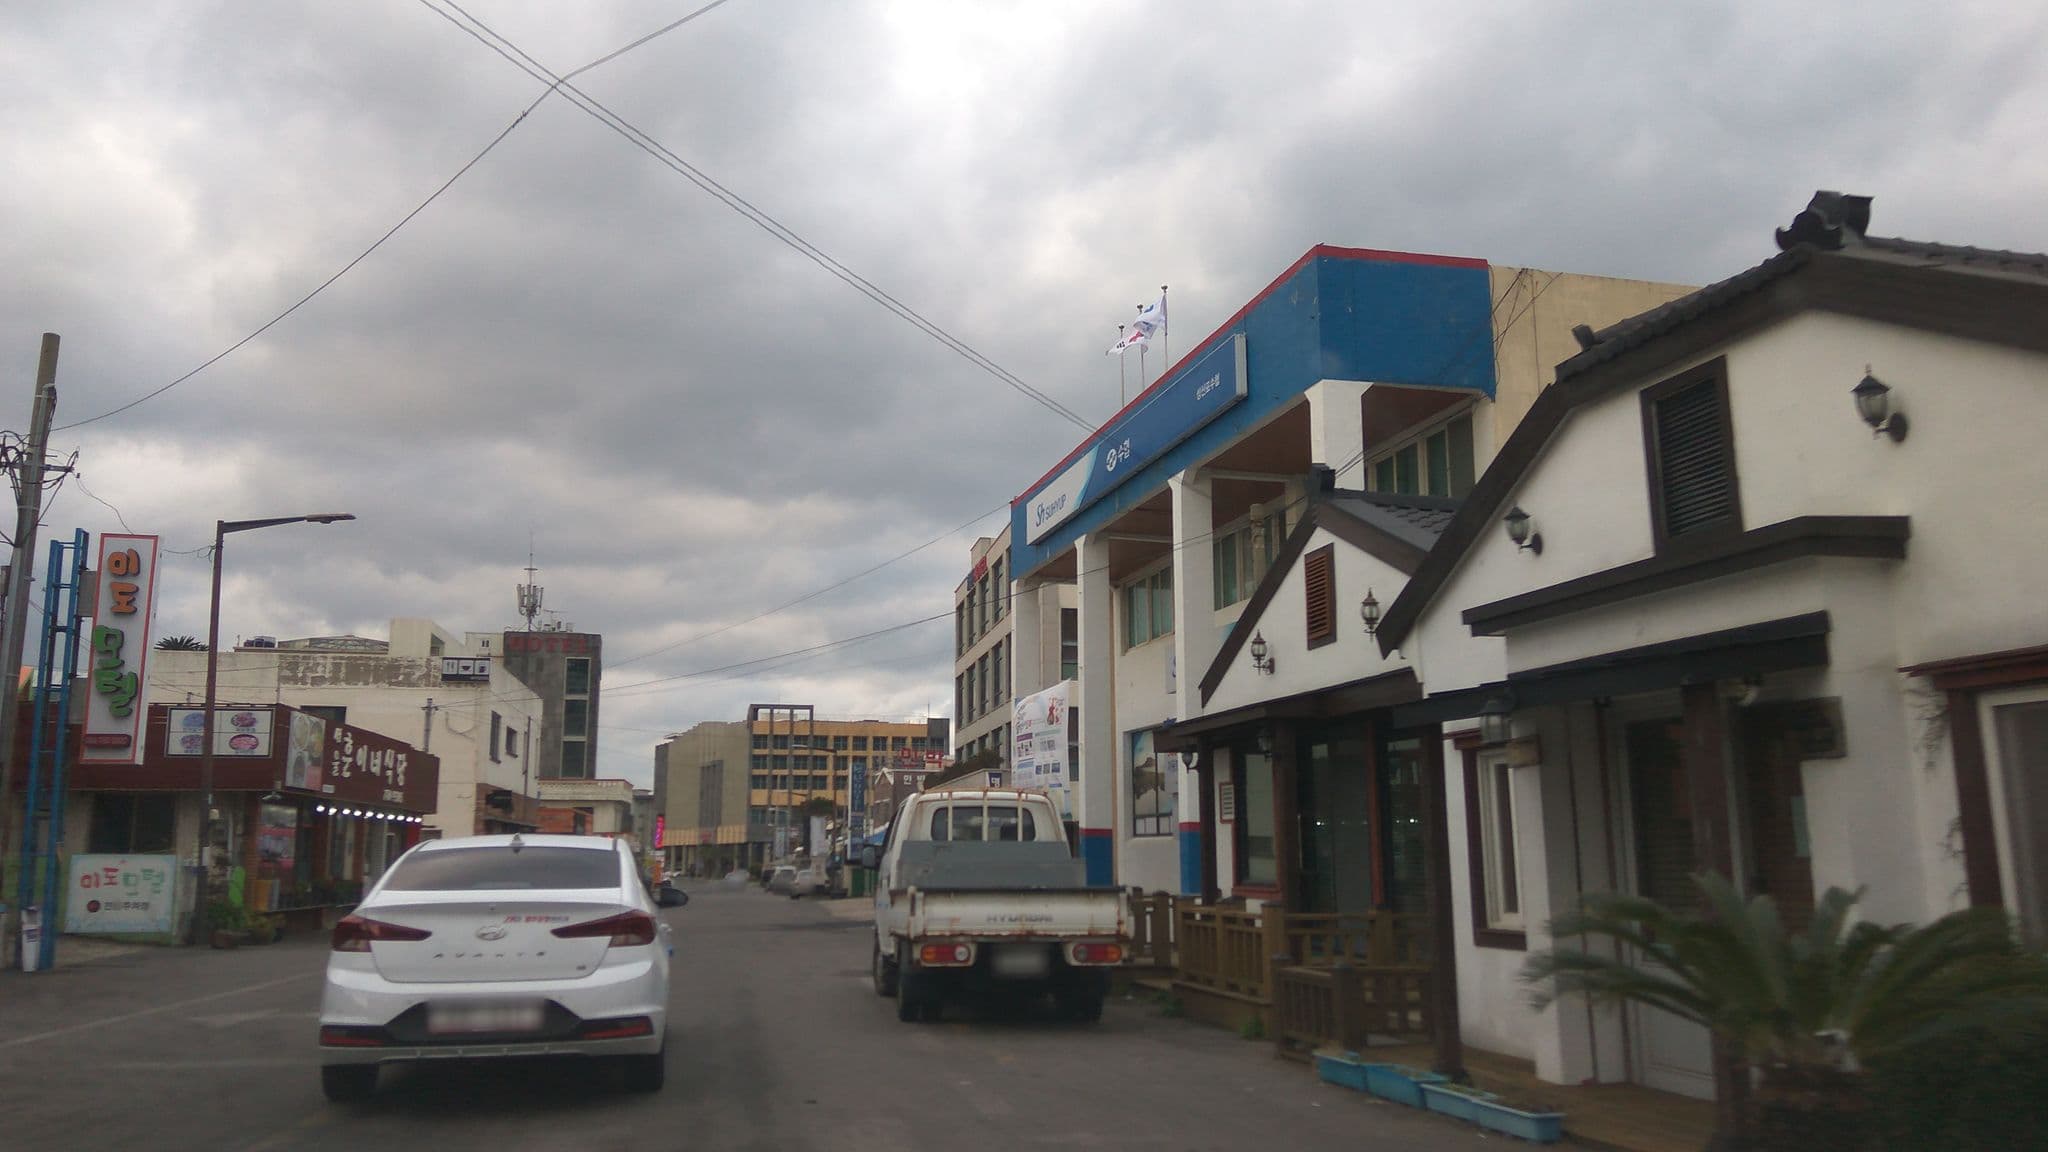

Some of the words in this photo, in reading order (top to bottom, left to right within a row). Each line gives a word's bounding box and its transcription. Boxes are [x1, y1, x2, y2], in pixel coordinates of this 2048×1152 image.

[1118, 437, 1130, 463] 수협
[107, 548, 140, 614] 이도
[508, 637, 591, 655] MOTEL
